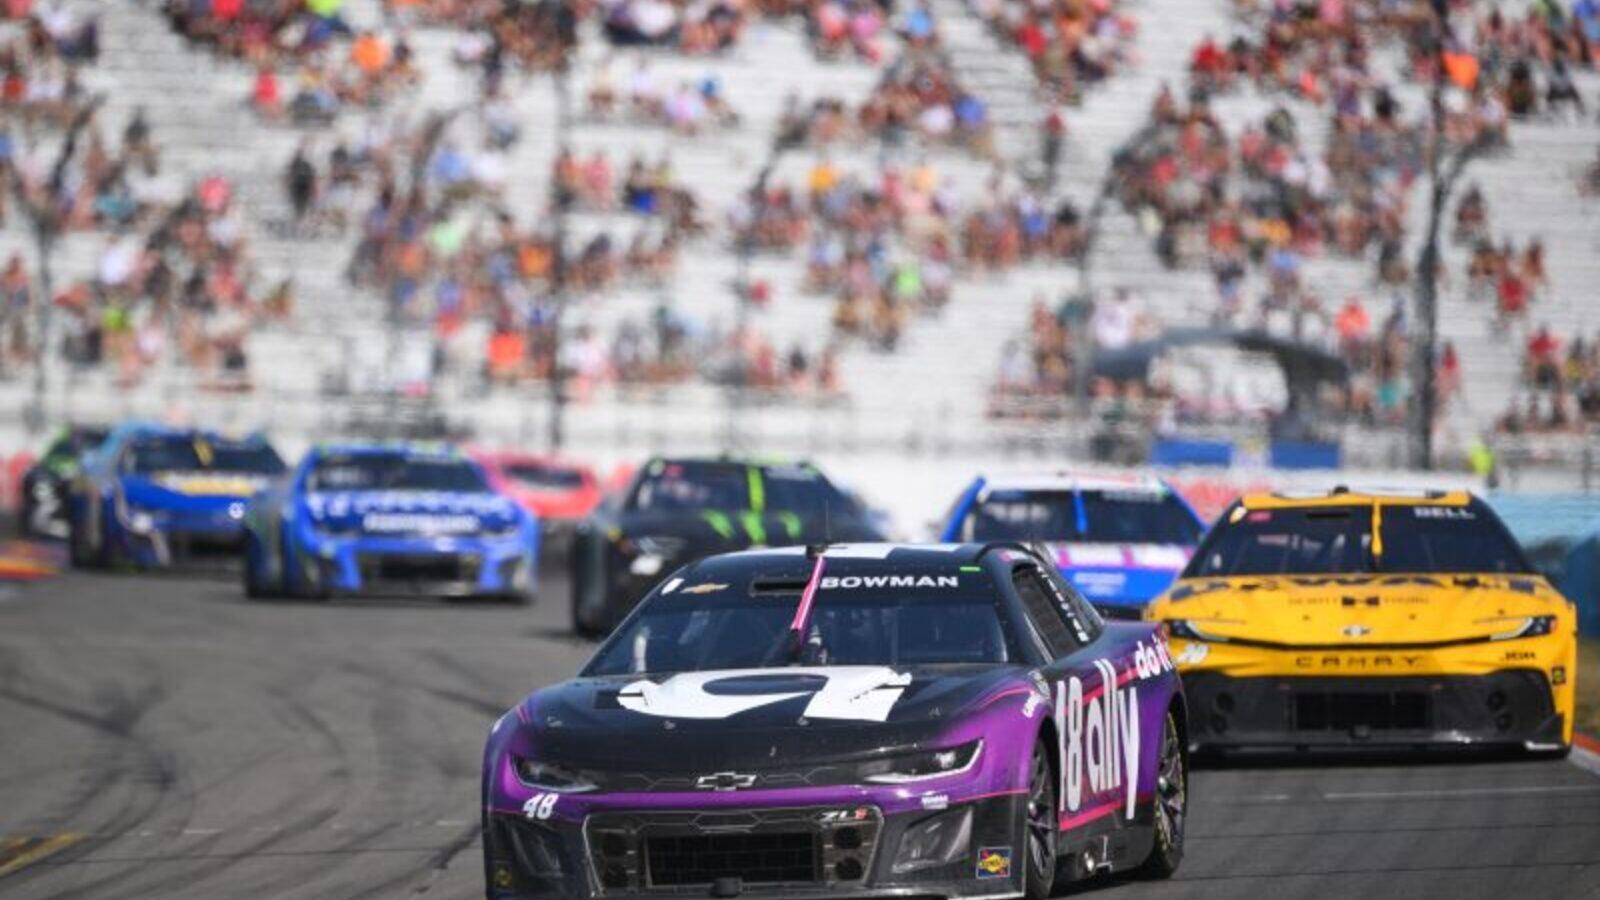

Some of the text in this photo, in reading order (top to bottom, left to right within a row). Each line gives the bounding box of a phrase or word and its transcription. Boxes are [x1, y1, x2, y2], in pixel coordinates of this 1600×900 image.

[1413, 506, 1476, 519] BELL
[820, 576, 959, 588] BOWMAN
[1296, 655, 1422, 668] CAMRY
[1087, 658, 1140, 820] ally
[523, 792, 559, 819] 48
